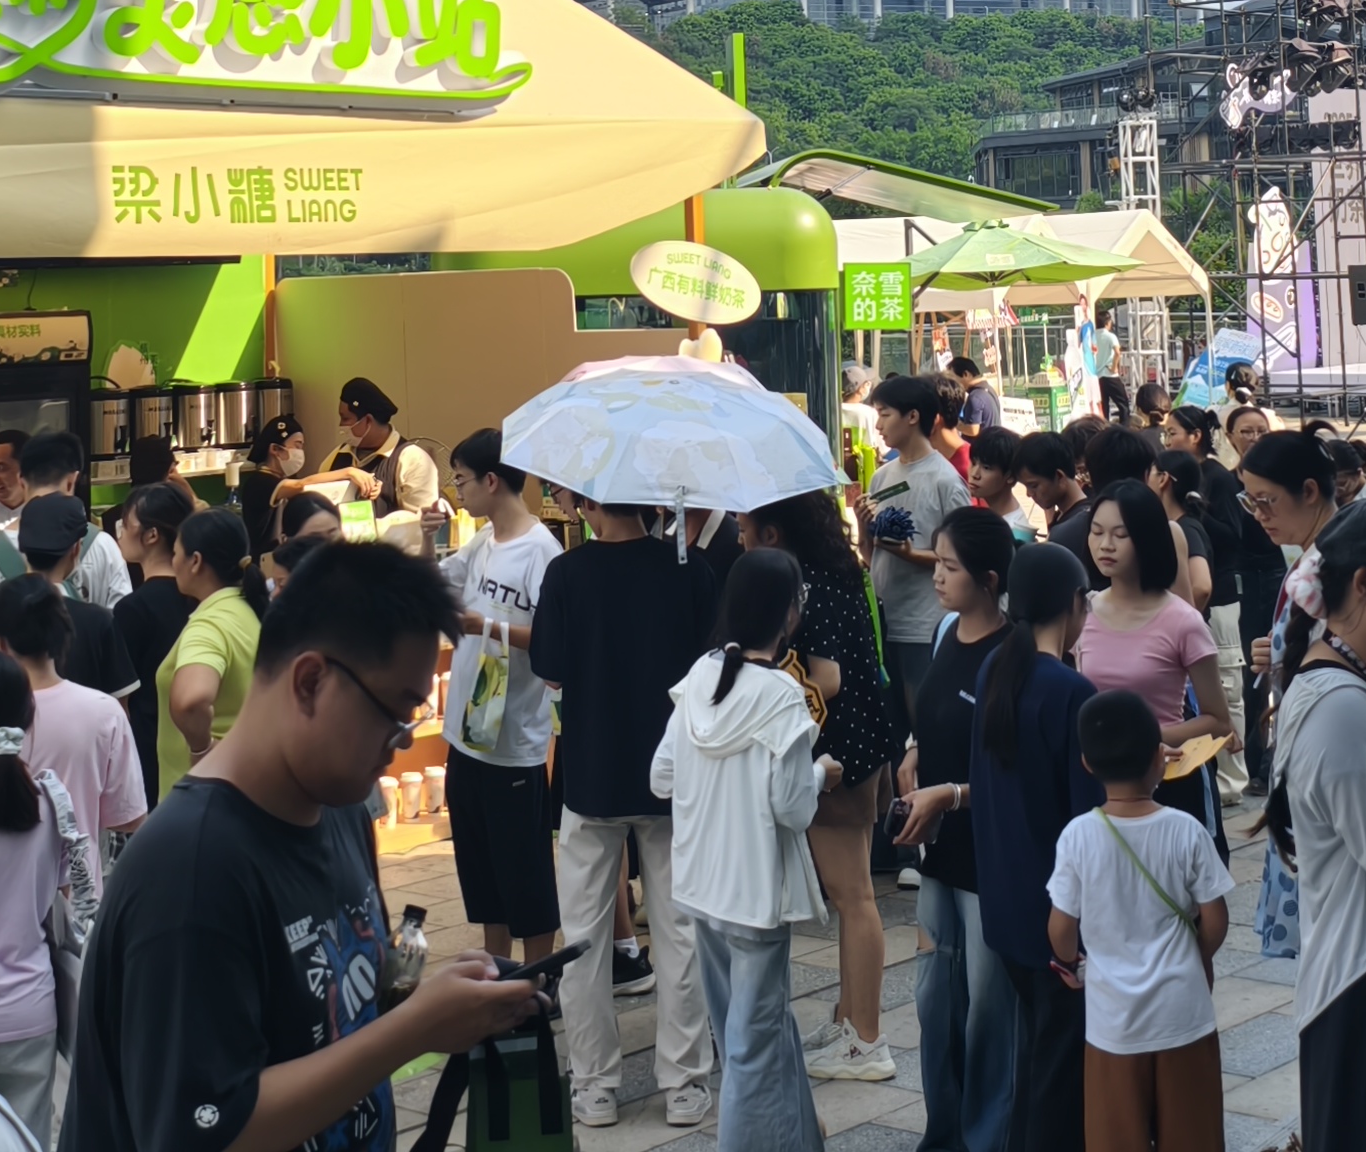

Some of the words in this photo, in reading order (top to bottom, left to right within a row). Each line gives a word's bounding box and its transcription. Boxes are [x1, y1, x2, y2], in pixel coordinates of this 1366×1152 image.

[283, 167, 363, 192] SWEET
[111, 165, 276, 225] 梁小糖
[286, 199, 357, 223] LIANG
[666, 251, 703, 266] SWEET
[703, 255, 732, 281] LIANG
[647, 266, 746, 310] 广西有料鲜奶茶
[851, 270, 905, 297] 奈雪
[852, 297, 905, 323] 的茶
[477, 574, 537, 612] NATU
